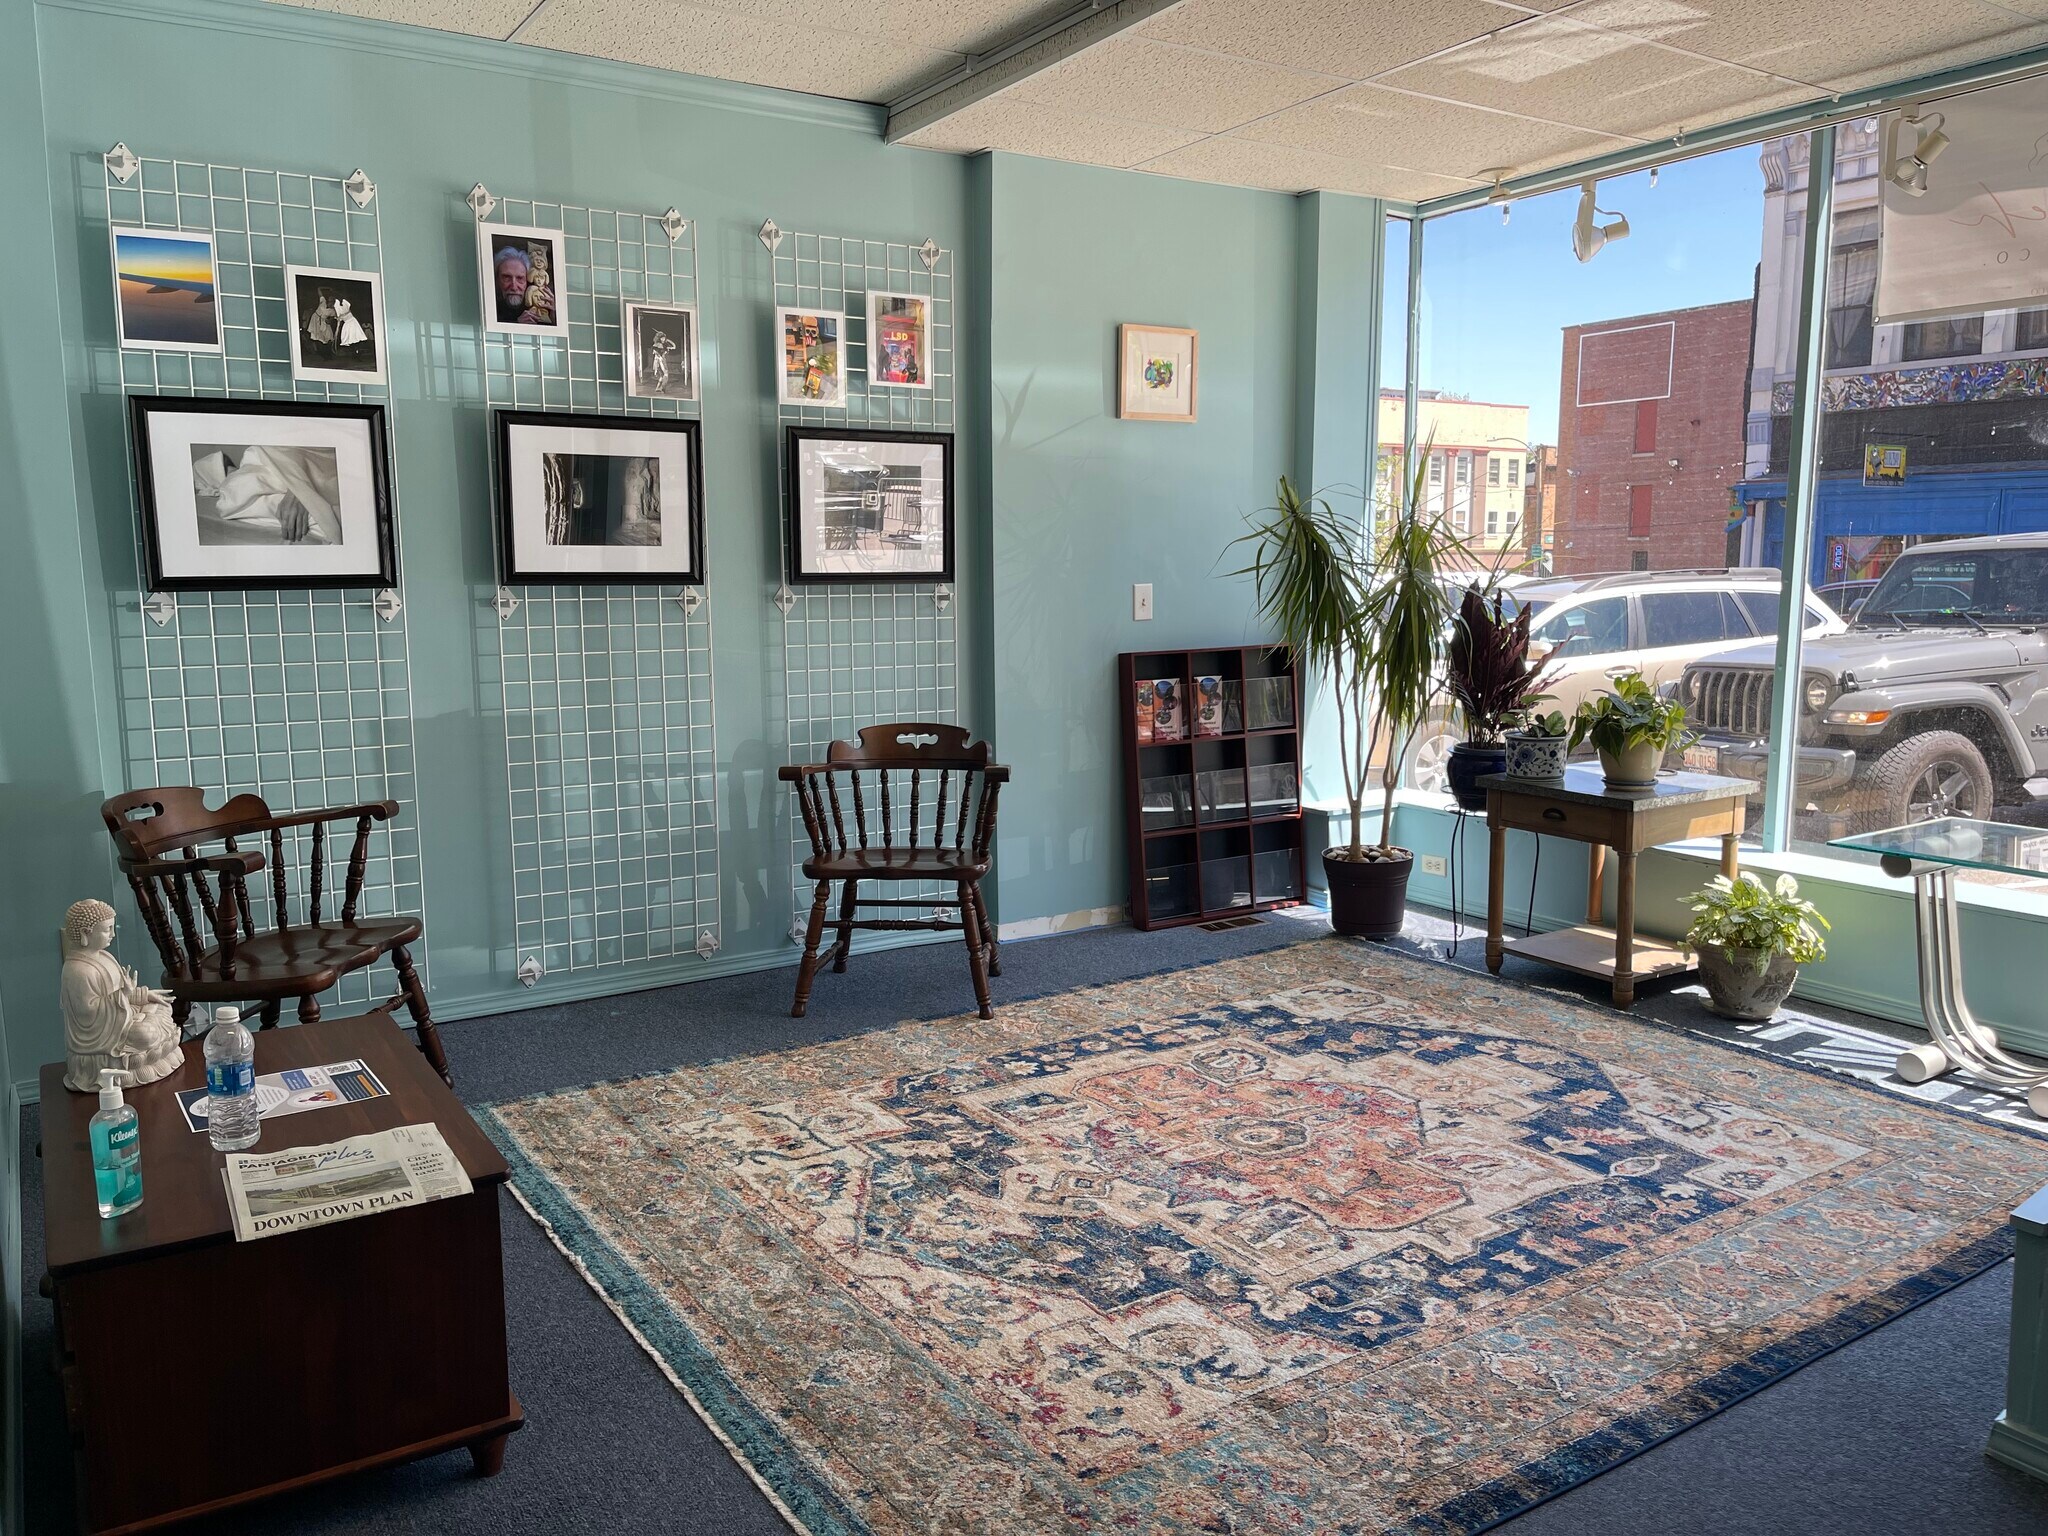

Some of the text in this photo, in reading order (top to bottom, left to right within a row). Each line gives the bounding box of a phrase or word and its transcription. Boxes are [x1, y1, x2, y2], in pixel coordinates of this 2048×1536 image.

[890, 331, 908, 341] LSD
[239, 1150, 337, 1169] PANTAGRAPH
[318, 1145, 373, 1168] plus
[412, 1162, 444, 1171] share
[415, 1168, 444, 1176] taxes
[253, 1190, 414, 1233] DOWNTOWN PLAN
